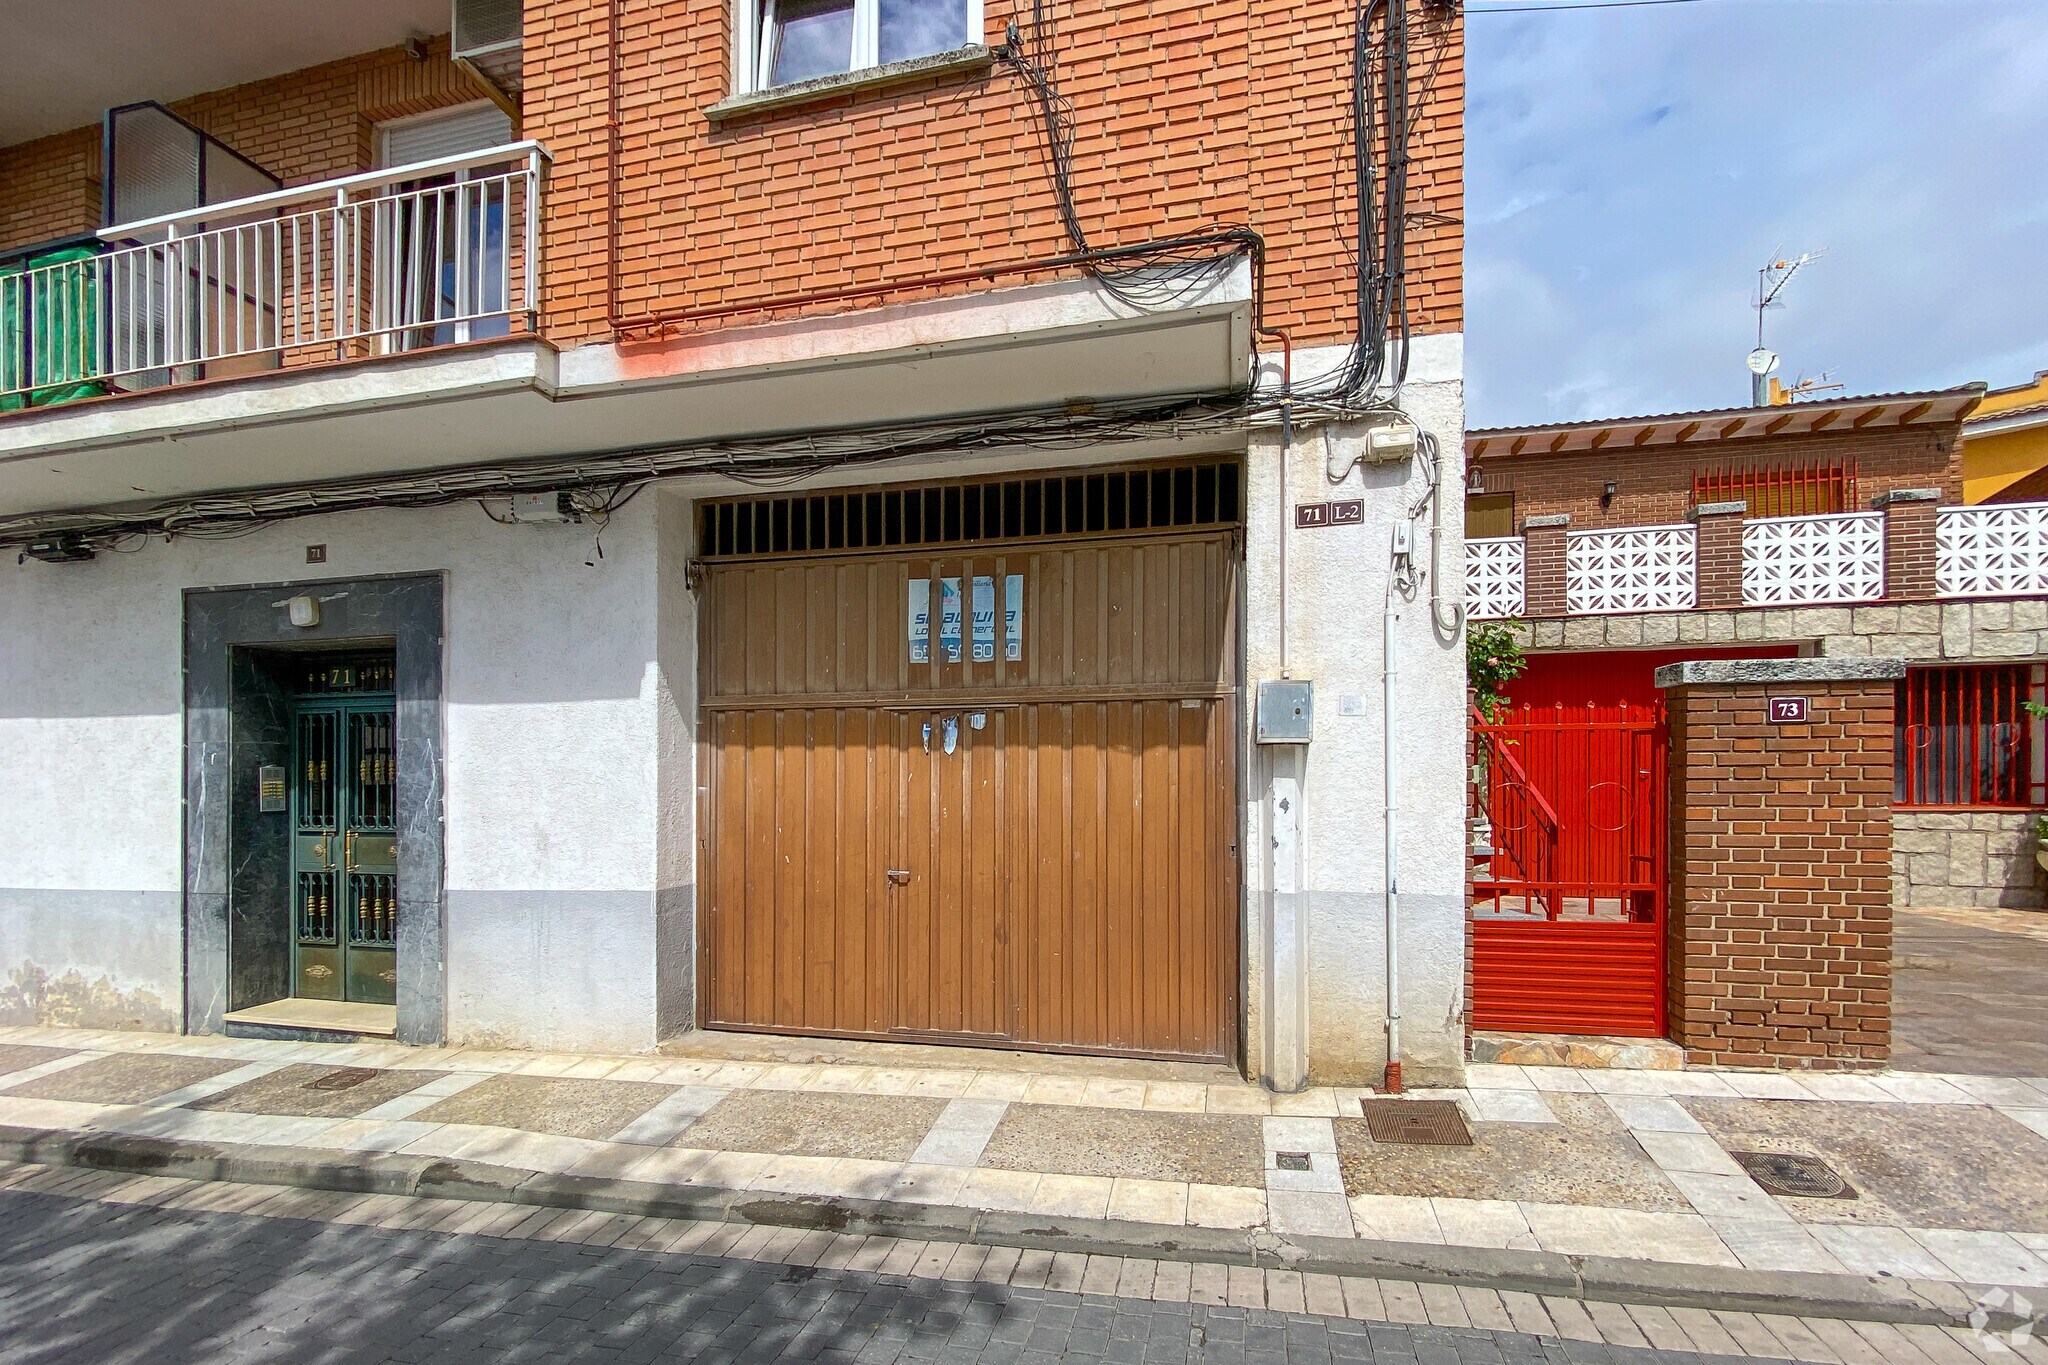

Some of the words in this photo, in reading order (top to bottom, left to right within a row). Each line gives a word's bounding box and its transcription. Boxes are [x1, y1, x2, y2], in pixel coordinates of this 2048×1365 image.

[1303, 507, 1321, 521] 71
[1334, 505, 1359, 520] L-2
[311, 548, 321, 558] 71
[331, 669, 351, 684] 71
[1777, 702, 1799, 717] 73
